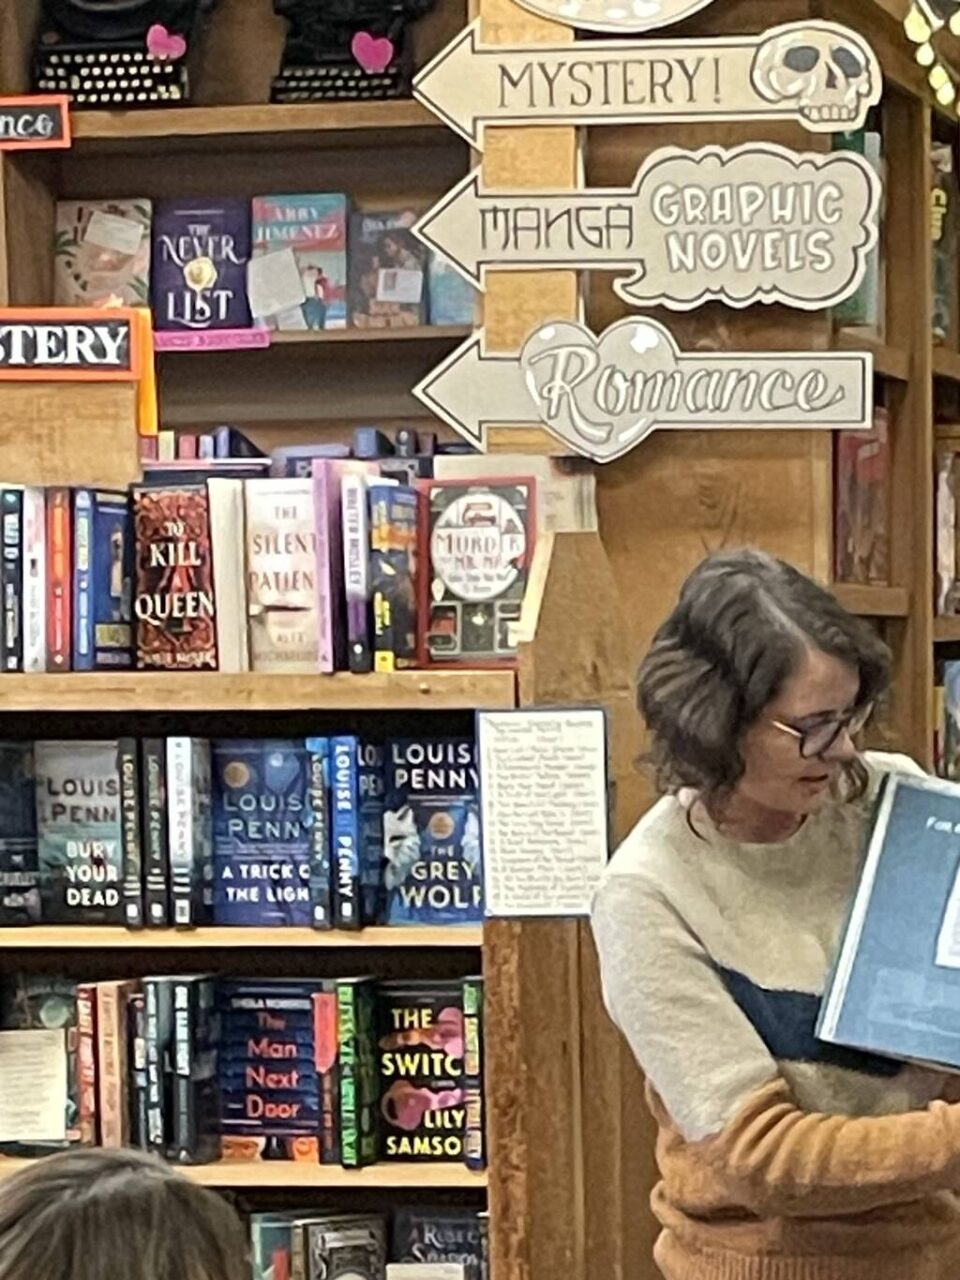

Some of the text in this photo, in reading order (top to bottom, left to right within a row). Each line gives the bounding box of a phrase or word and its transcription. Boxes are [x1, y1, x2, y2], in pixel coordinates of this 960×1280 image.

[499, 57, 722, 108] MYSTERY!
[651, 181, 844, 226] GRAPHIC
[255, 223, 338, 243] JIMENEZ
[478, 203, 633, 251] MANGA
[158, 234, 247, 266] NEVER
[665, 229, 834, 274] NOVELS
[167, 288, 234, 328] LIST
[0, 325, 129, 365] TERY
[529, 344, 846, 444] Romance
[274, 506, 298, 520] THE
[149, 541, 202, 567] KILL
[436, 533, 520, 554] MURDR
[347, 537, 361, 585] MOSLEY
[249, 570, 314, 593] PATIEN
[134, 591, 216, 627] QUEEN
[392, 743, 479, 766] LOUIS
[46, 778, 119, 797] LOUIS
[50, 803, 118, 823] PENN
[122, 753, 138, 863] LOUISE PENNY
[147, 755, 162, 861] LOUISE PENNY
[174, 753, 188, 860] LOUISE PENNY
[223, 793, 303, 812] LOUIS
[311, 752, 323, 861] LOUISE PENNY
[228, 818, 301, 839] PENN
[335, 744, 354, 898] LOUISE PENNY
[65, 841, 118, 859] BURY
[432, 845, 454, 857] THE
[65, 864, 119, 883] YOUR
[221, 864, 234, 880] A
[239, 864, 294, 880] TRICK
[410, 860, 476, 881] GREY
[65, 888, 120, 907] DEAD
[225, 887, 310, 903] THE LIGH
[391, 1007, 434, 1029] THE
[247, 1037, 298, 1059] Man
[381, 1052, 463, 1077] SWITC
[245, 1066, 300, 1089] Next
[245, 1094, 301, 1118] Door
[424, 1109, 466, 1129] LILY
[386, 1136, 463, 1156] SAMSO
